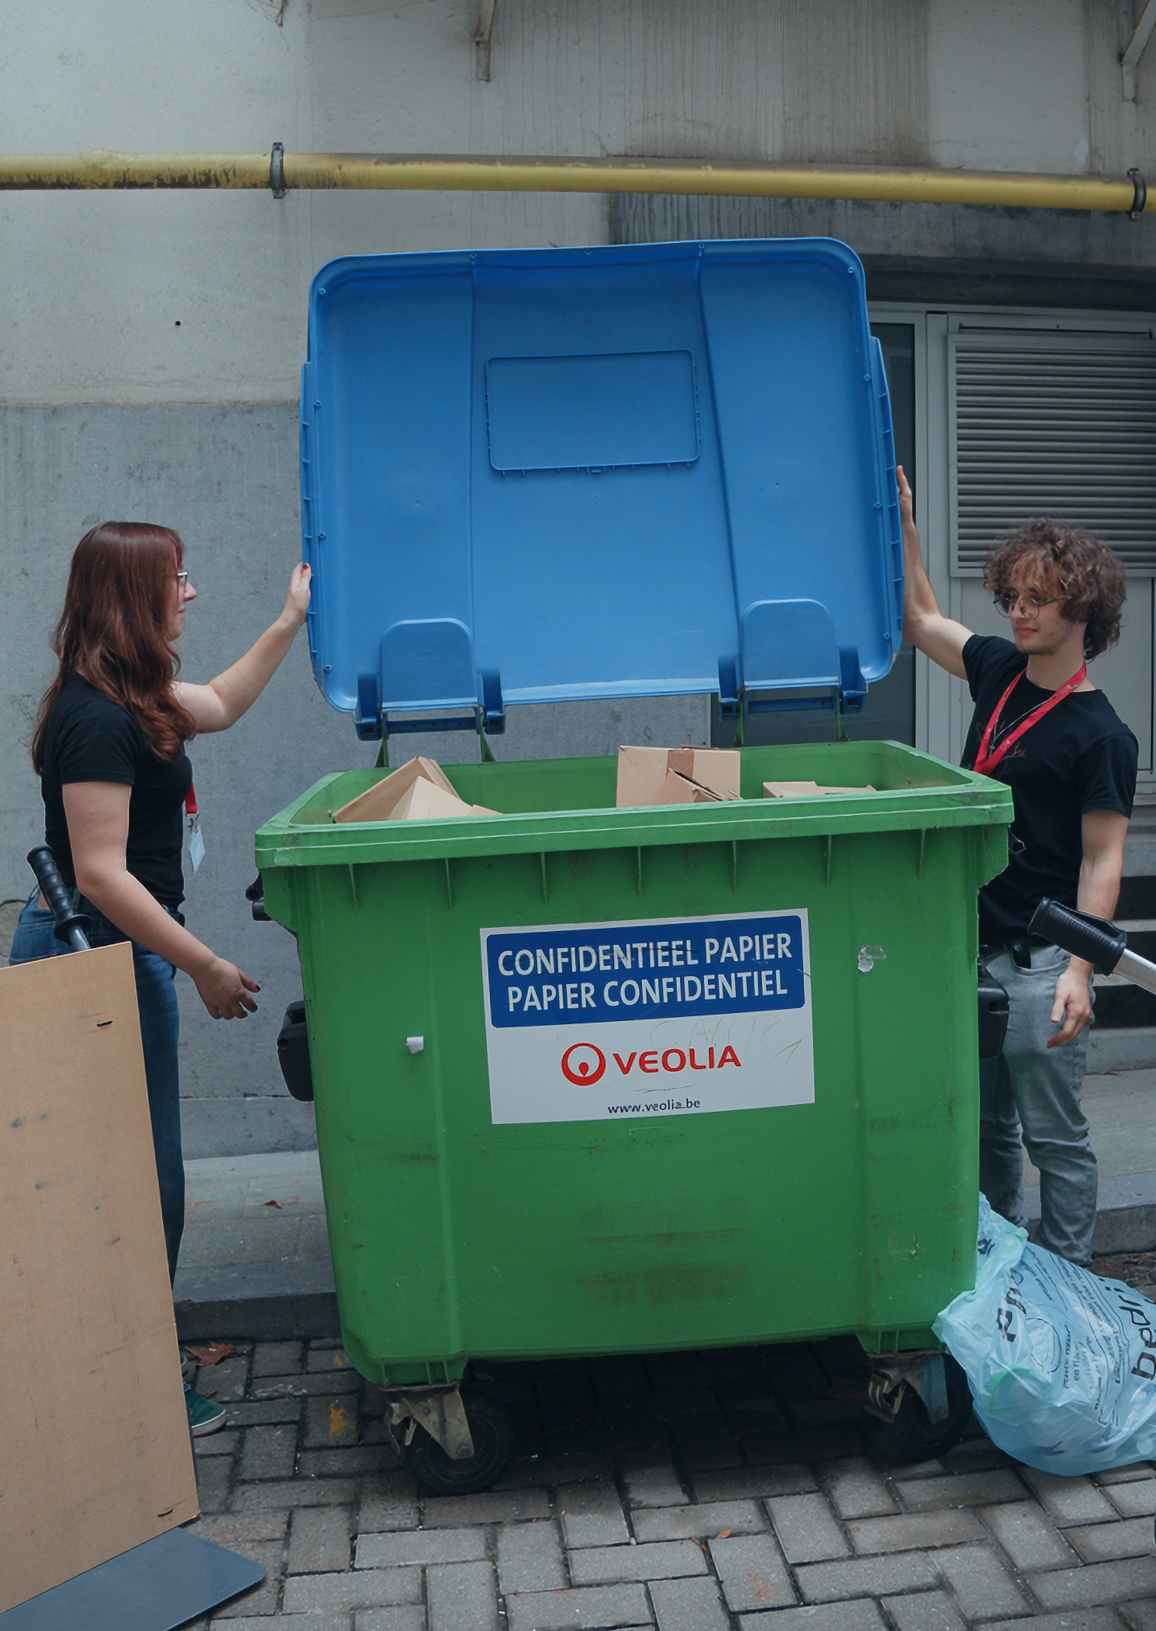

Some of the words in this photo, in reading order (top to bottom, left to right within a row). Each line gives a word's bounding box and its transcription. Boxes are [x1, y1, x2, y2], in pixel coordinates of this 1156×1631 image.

[498, 939, 699, 976] CONFIDENTIEEL
[705, 933, 793, 963] PAPIER
[508, 982, 597, 1012] PAPIER
[603, 970, 788, 1006] CONFIDENTIEL
[612, 1045, 742, 1075] VEOLIA
[607, 1099, 701, 1115] www.veolia.be
